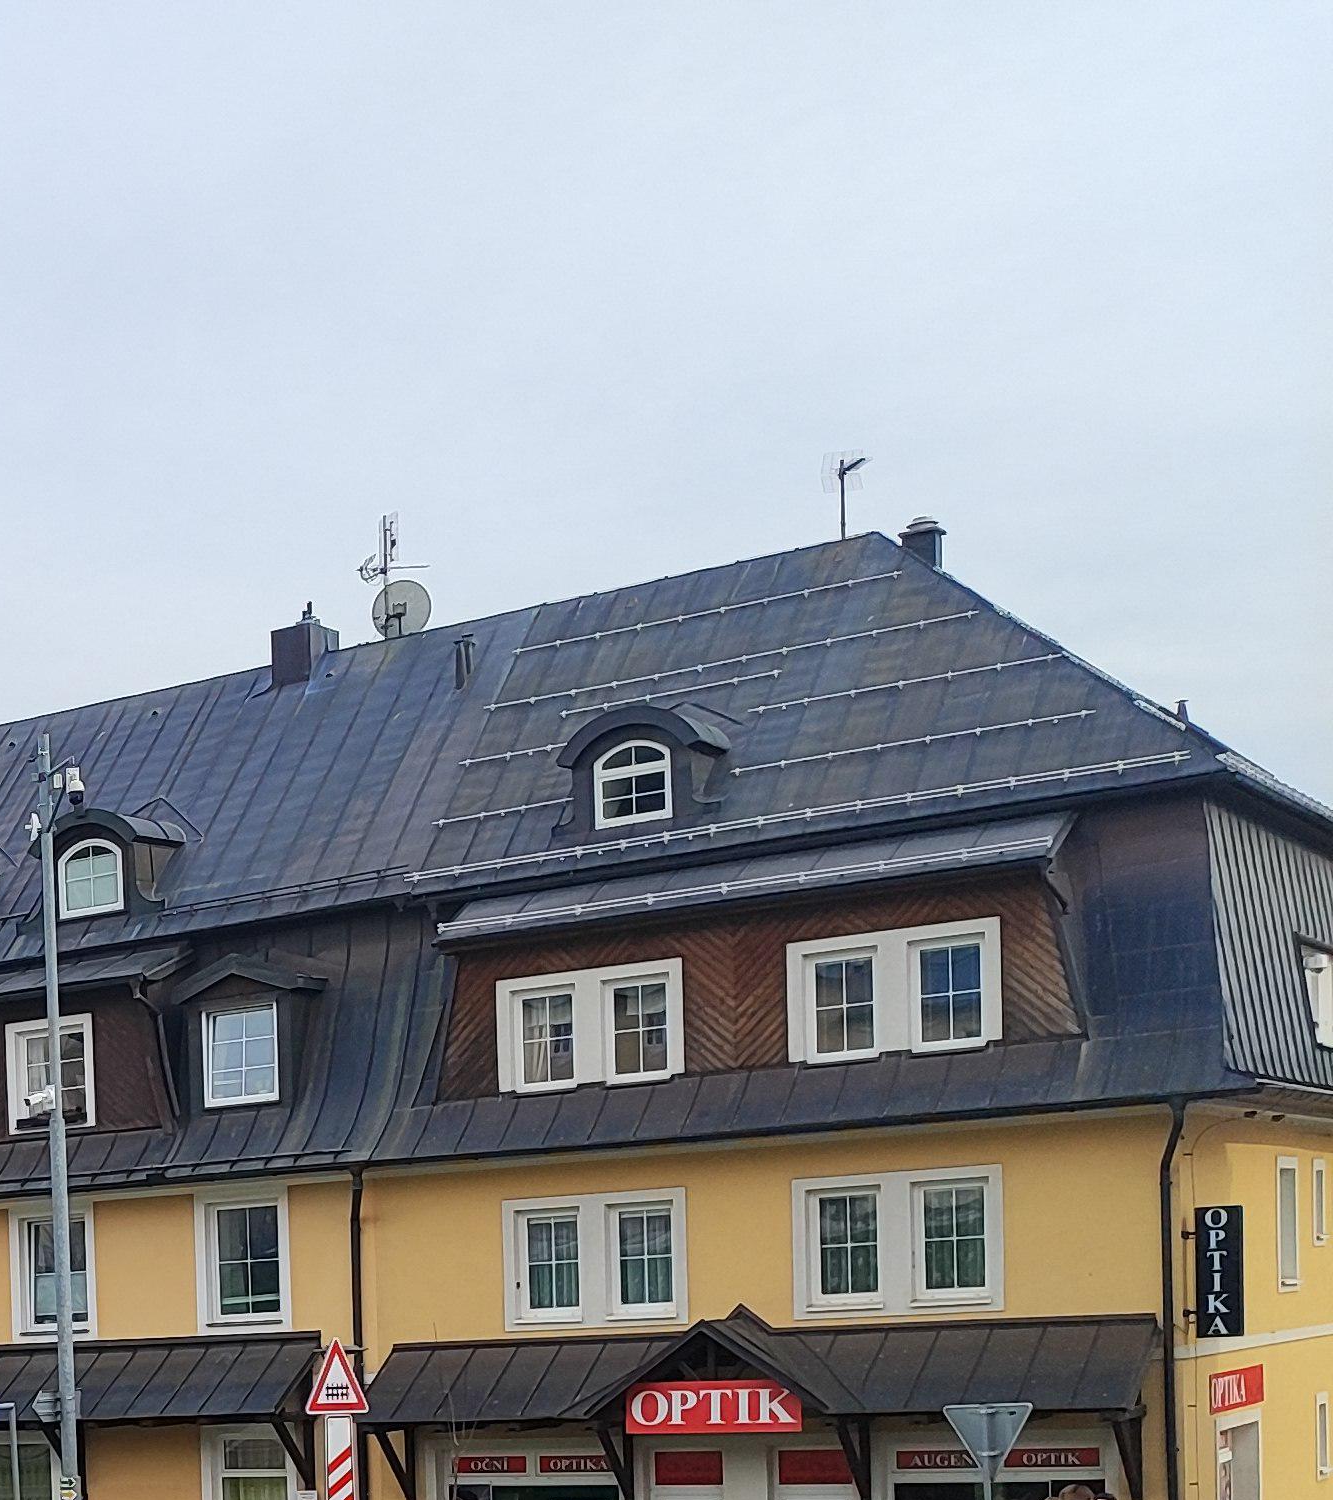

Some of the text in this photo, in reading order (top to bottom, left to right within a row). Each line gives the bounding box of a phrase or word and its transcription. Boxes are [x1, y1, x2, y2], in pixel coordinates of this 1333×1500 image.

[1204, 1208, 1230, 1335] OPTIKA
[631, 1388, 798, 1426] OPTIK
[1211, 1374, 1246, 1409] OPTIKA
[470, 1456, 610, 1471] OČNÍ OPTIKA
[1022, 1451, 1081, 1466] OPTIK
